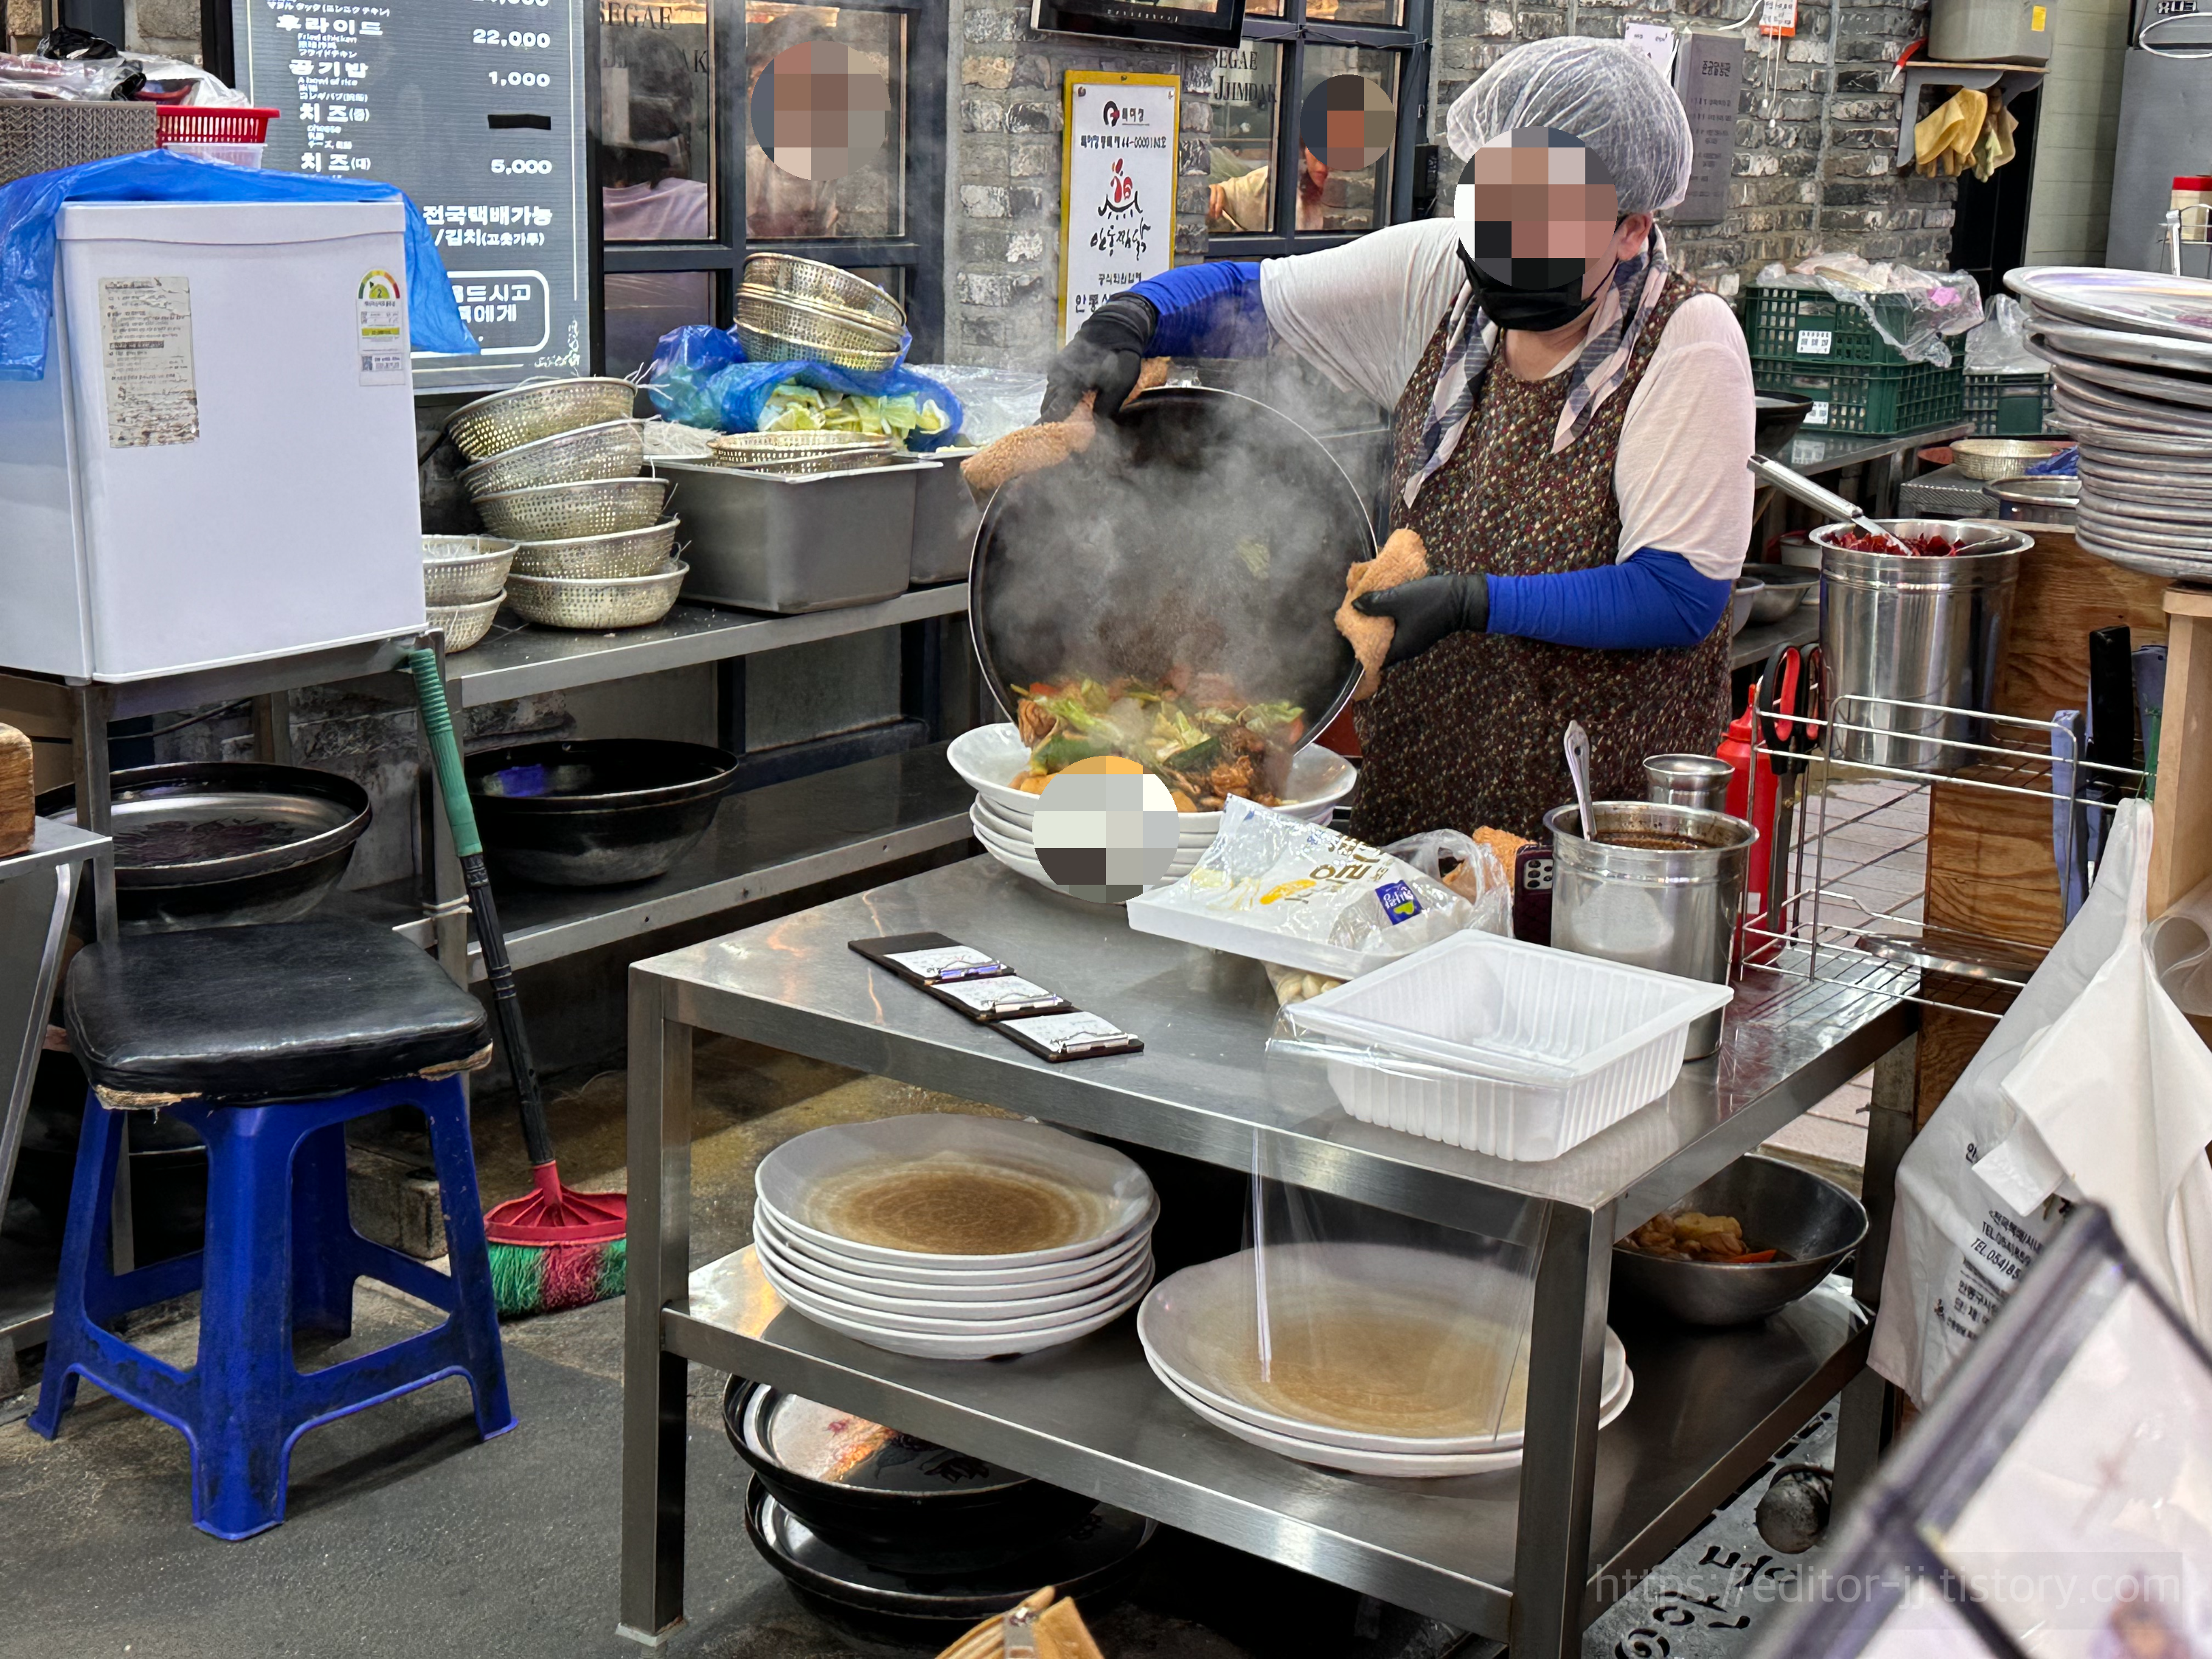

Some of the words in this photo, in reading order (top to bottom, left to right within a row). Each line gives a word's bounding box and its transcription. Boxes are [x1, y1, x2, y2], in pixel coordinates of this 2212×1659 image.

[276, 14, 383, 35] 후라이드
[473, 28, 551, 49] 22,000
[289, 59, 369, 78] 공기밥
[488, 71, 551, 87] 1,000
[491, 159, 552, 175] 5,000
[422, 205, 553, 226] 전국택배가능
